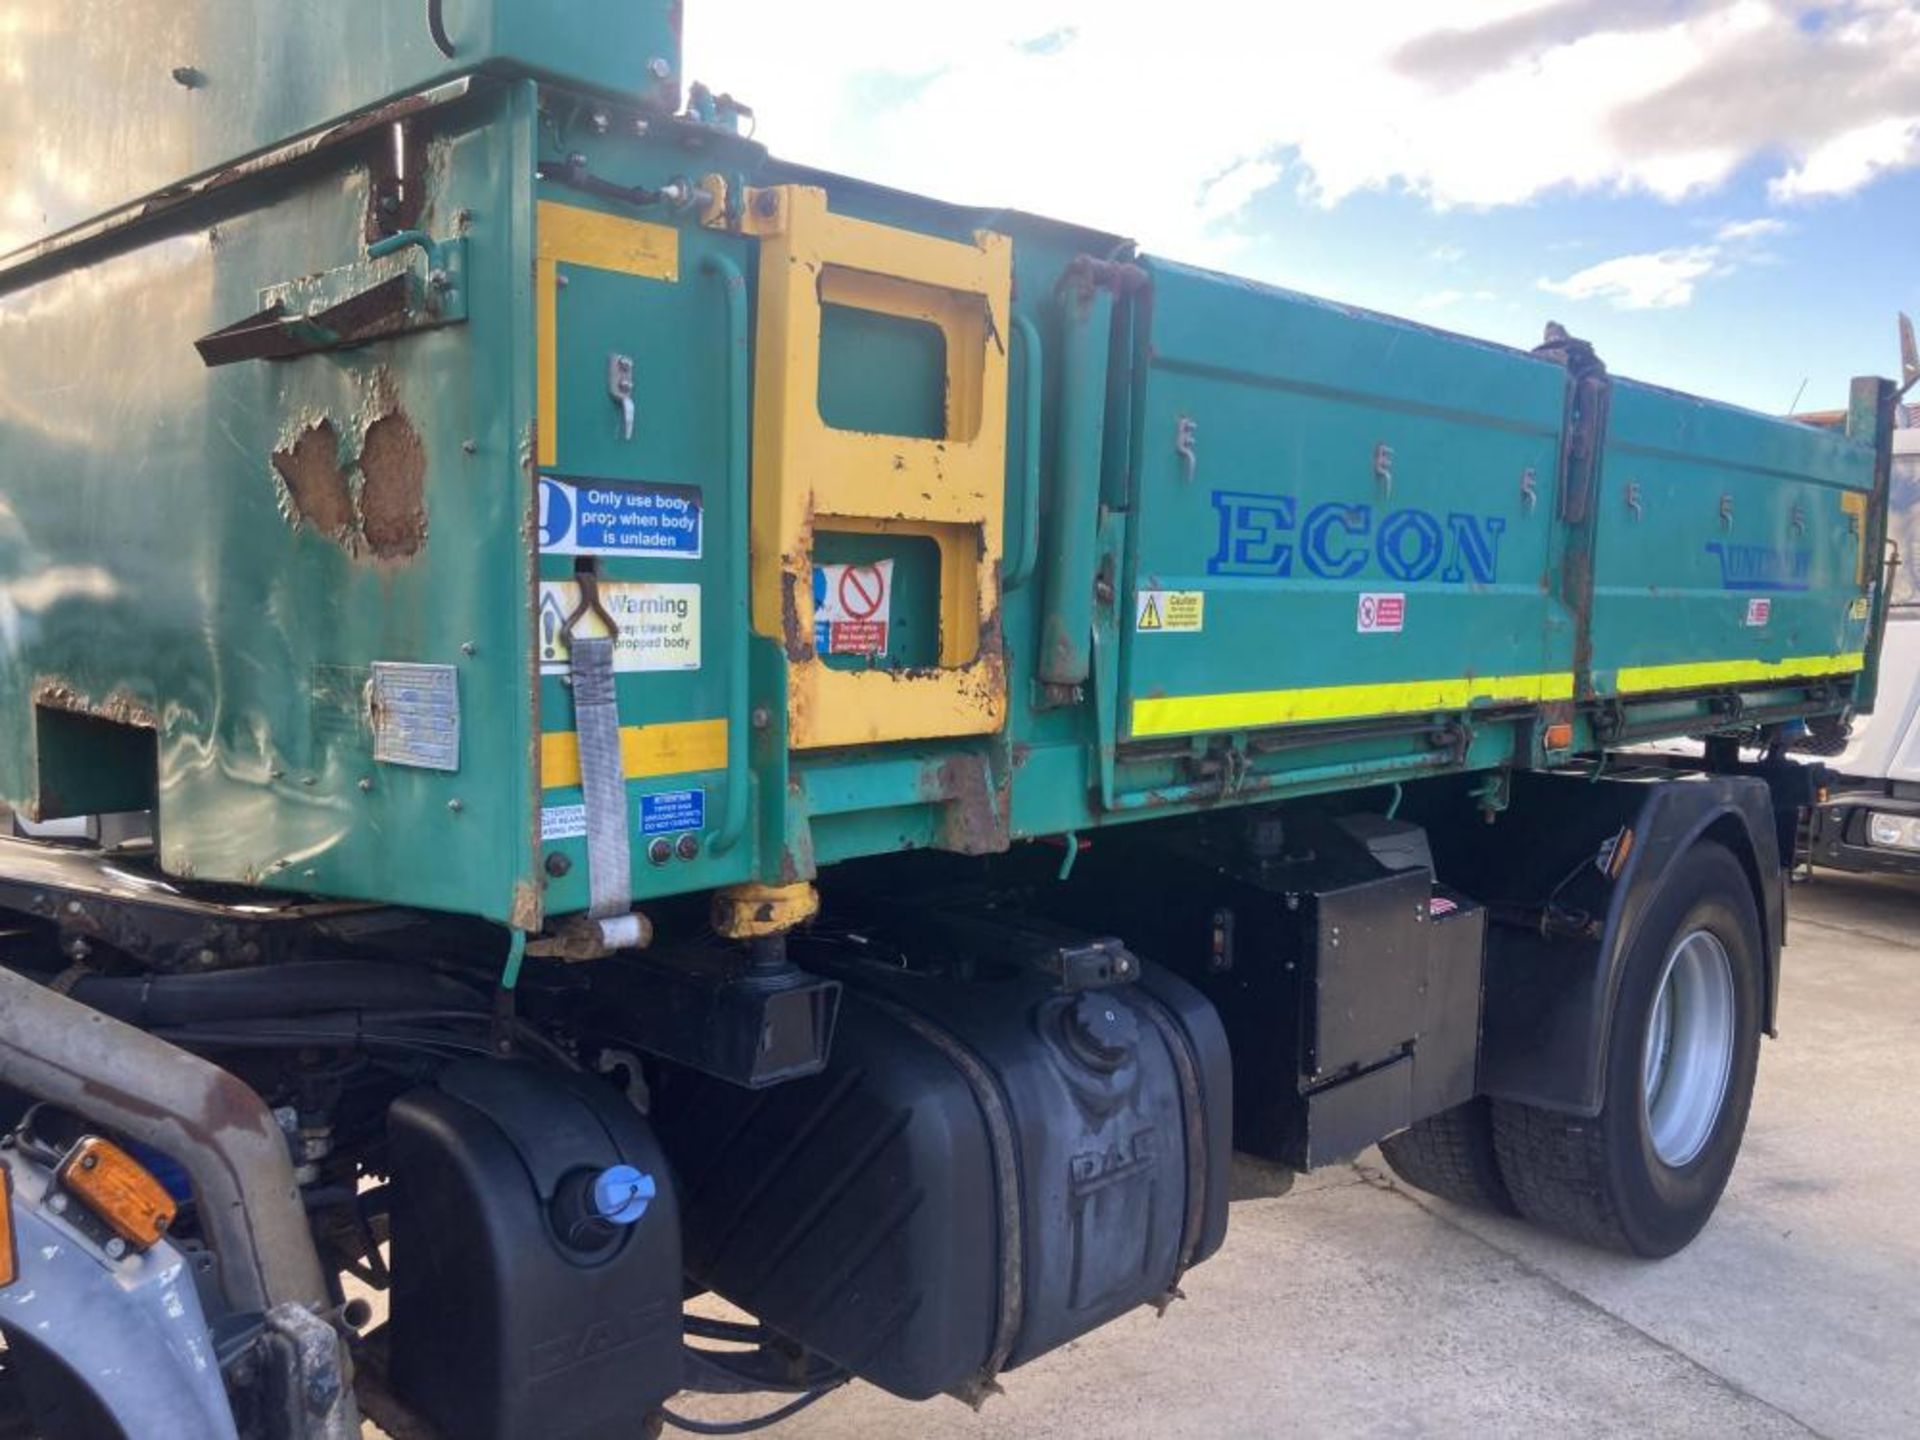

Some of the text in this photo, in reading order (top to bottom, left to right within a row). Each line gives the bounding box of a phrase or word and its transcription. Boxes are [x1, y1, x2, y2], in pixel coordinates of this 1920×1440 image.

[588, 490, 691, 513] Only use body
[581, 512, 695, 532] prop when body
[602, 530, 677, 547] is unladen
[1206, 490, 1505, 584] ECON
[608, 594, 688, 618] Warning
[671, 622, 683, 633] of
[663, 637, 690, 651] body
